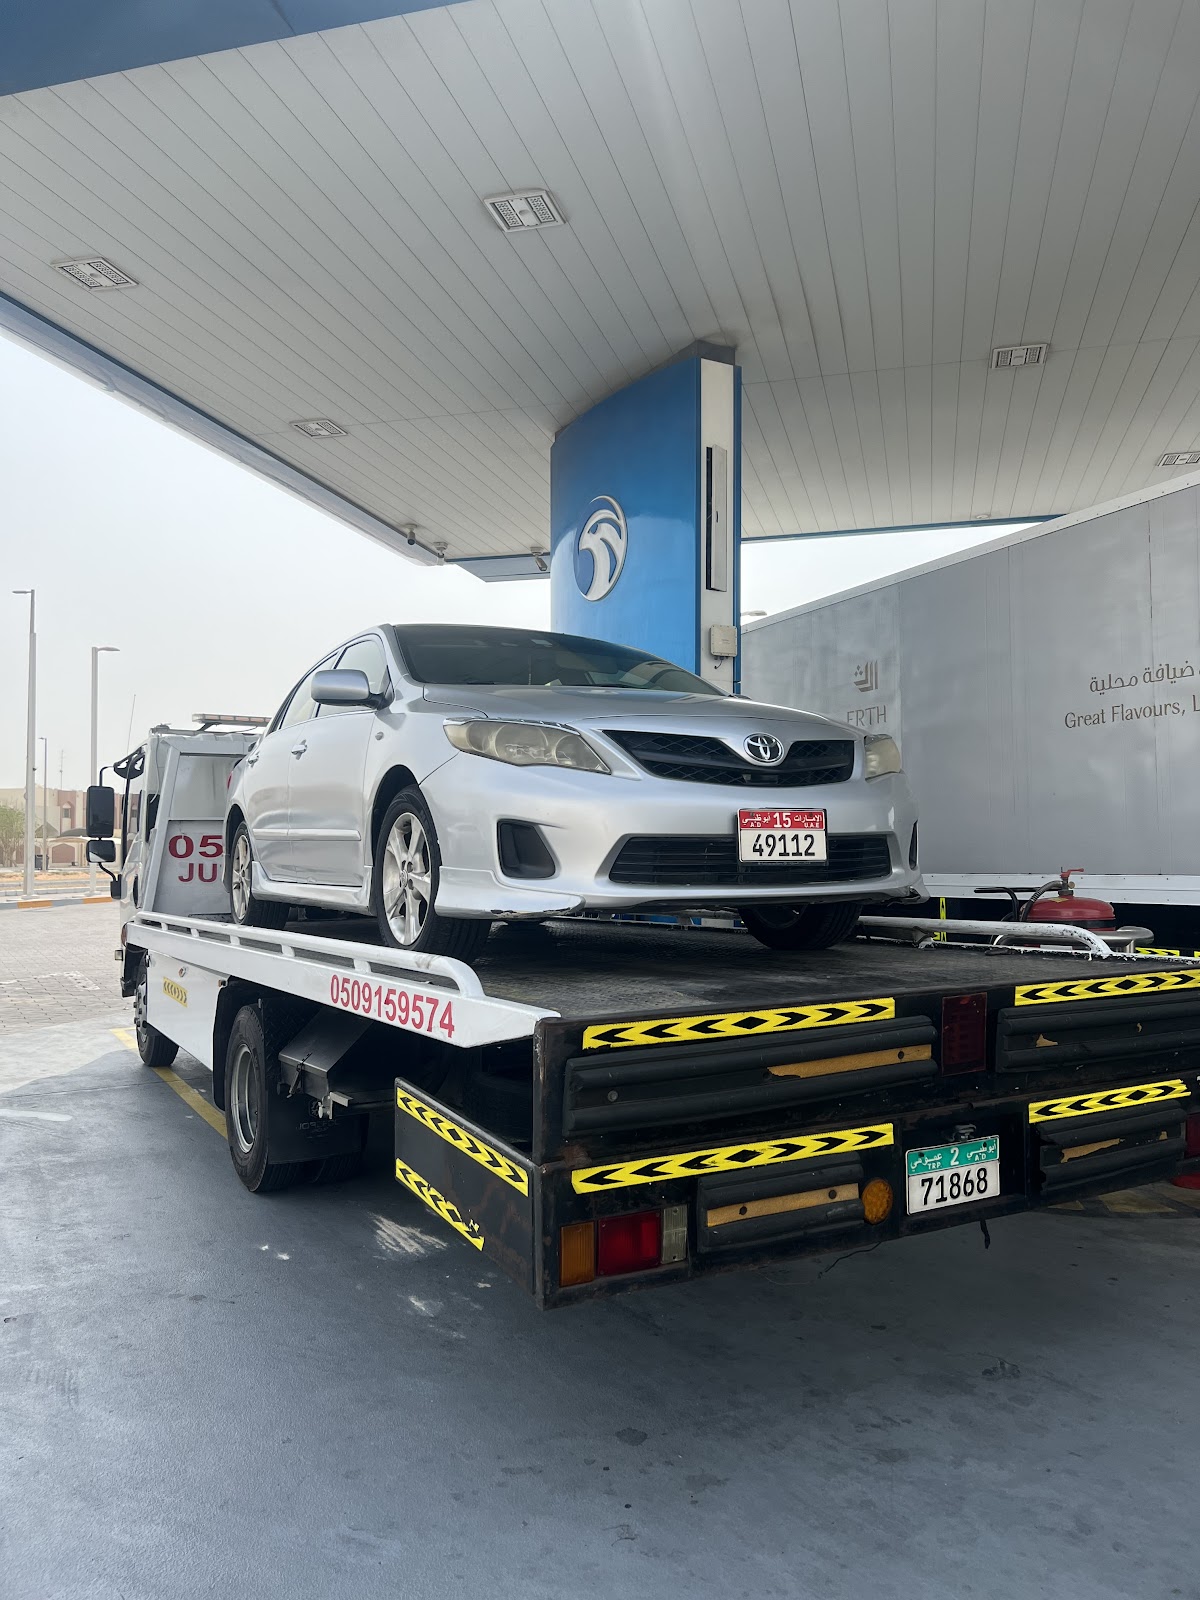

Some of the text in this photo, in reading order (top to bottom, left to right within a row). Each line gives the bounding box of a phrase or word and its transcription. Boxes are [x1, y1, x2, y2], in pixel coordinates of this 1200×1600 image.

[1089, 660, 1195, 695] ضيافة محلية
[1064, 709, 1106, 729] Great
[1111, 703, 1186, 722] Flavours,
[773, 811, 791, 828] 15
[752, 833, 816, 857] 49112
[330, 974, 455, 1039] 0509159574
[950, 1146, 960, 1166] 2
[920, 1166, 988, 1206] 71868
